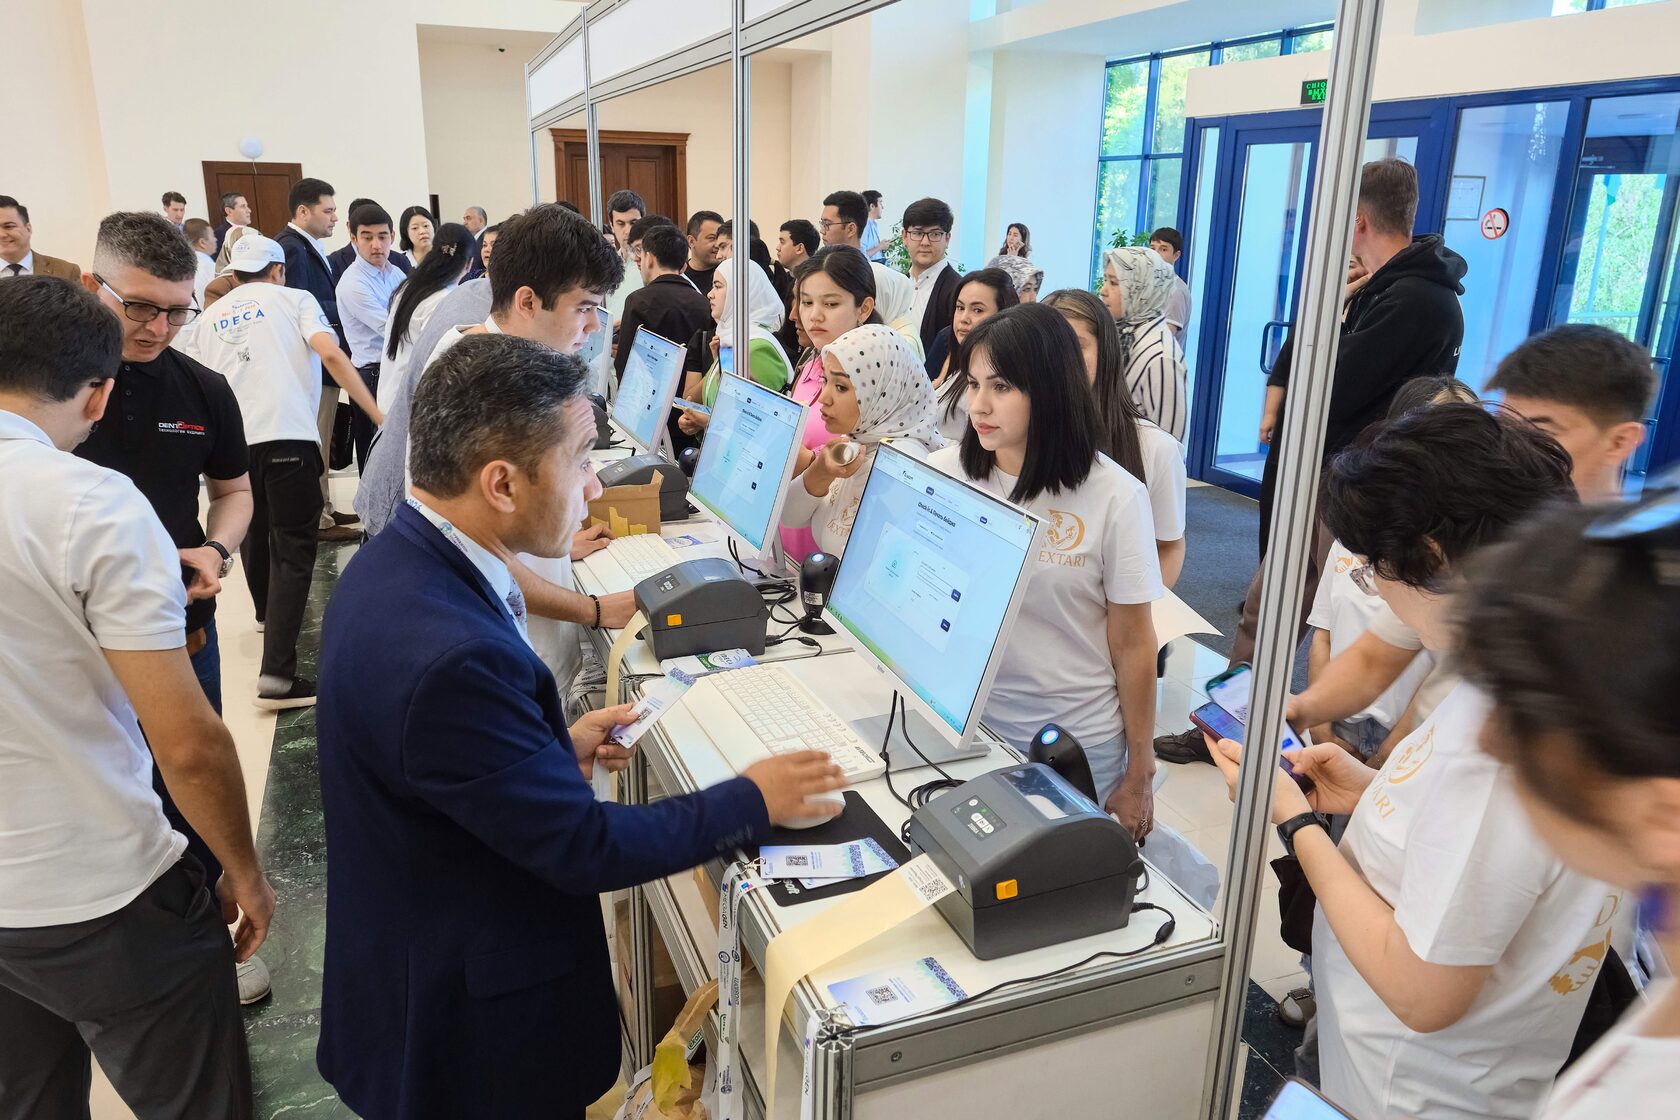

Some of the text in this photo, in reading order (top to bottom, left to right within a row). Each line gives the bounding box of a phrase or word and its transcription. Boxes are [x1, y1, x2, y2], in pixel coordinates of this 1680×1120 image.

[1306, 81, 1326, 89] CHIQ
[213, 309, 265, 332] IDECA
[1038, 550, 1086, 568] EXTARI
